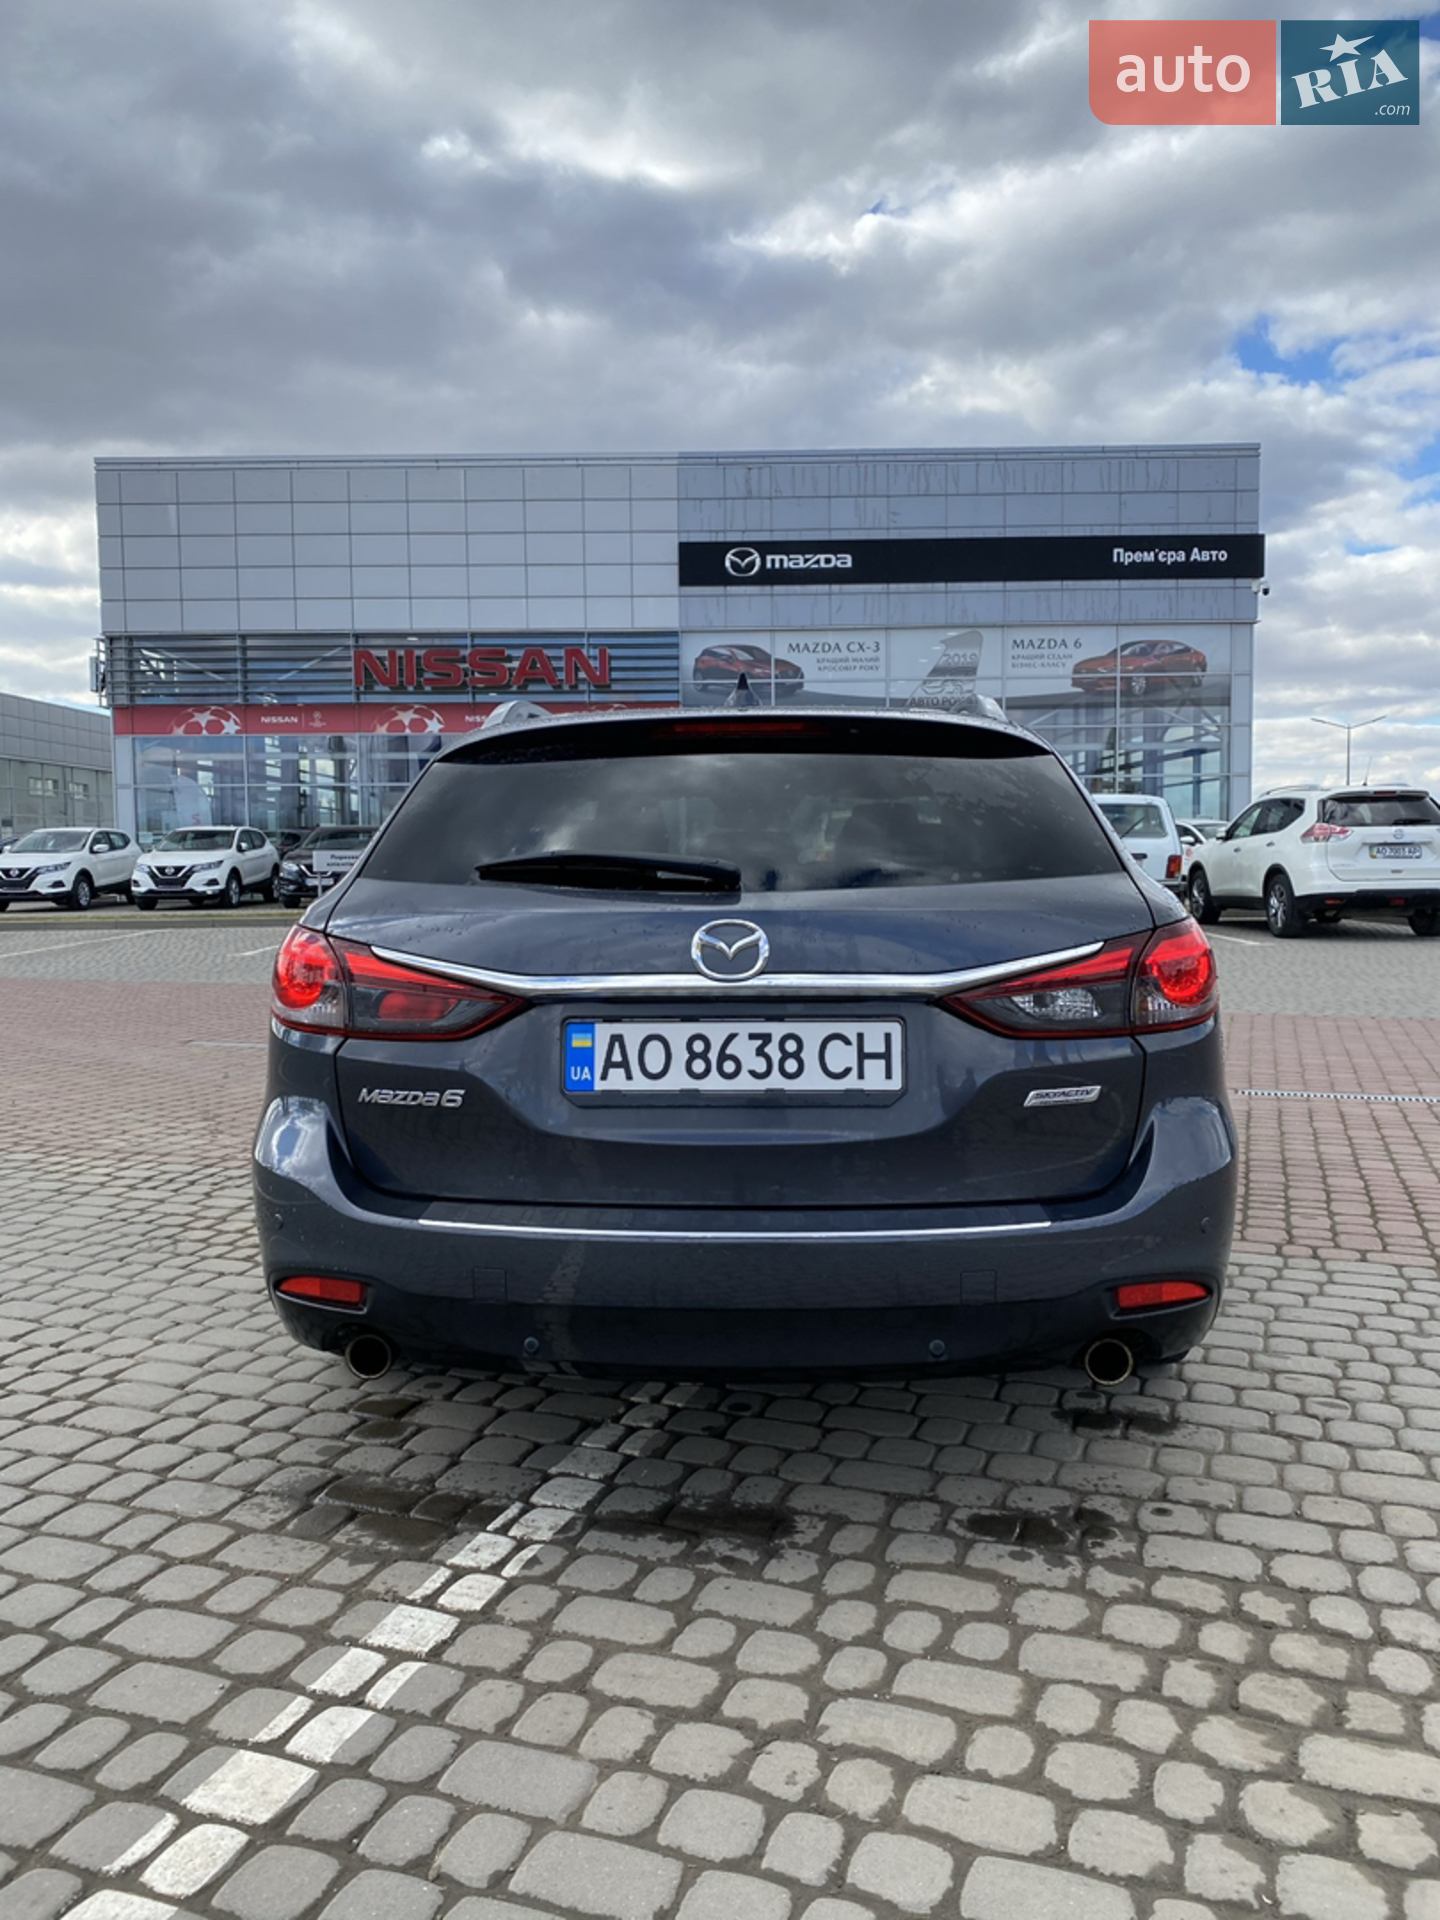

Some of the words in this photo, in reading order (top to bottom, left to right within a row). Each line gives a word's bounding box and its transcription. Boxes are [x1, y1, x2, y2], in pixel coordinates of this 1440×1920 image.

[1190, 547, 1229, 561] Авто
[766, 553, 853, 569] mazda
[787, 641, 842, 653] MAZDA
[846, 641, 881, 652] CX-3
[1011, 638, 1068, 650] MAZDA
[1074, 638, 1083, 649] 6
[1011, 653, 1046, 661] КРАЩИЙ
[1047, 653, 1073, 661] СЕДАН
[353, 647, 609, 687] NISSAN
[859, 664, 880, 672] РОКУ
[909, 696, 940, 707] АВТО
[599, 1033, 673, 1081] AO
[685, 1033, 805, 1080] 8638
[818, 1032, 894, 1080] CH
[571, 1067, 592, 1081] UA
